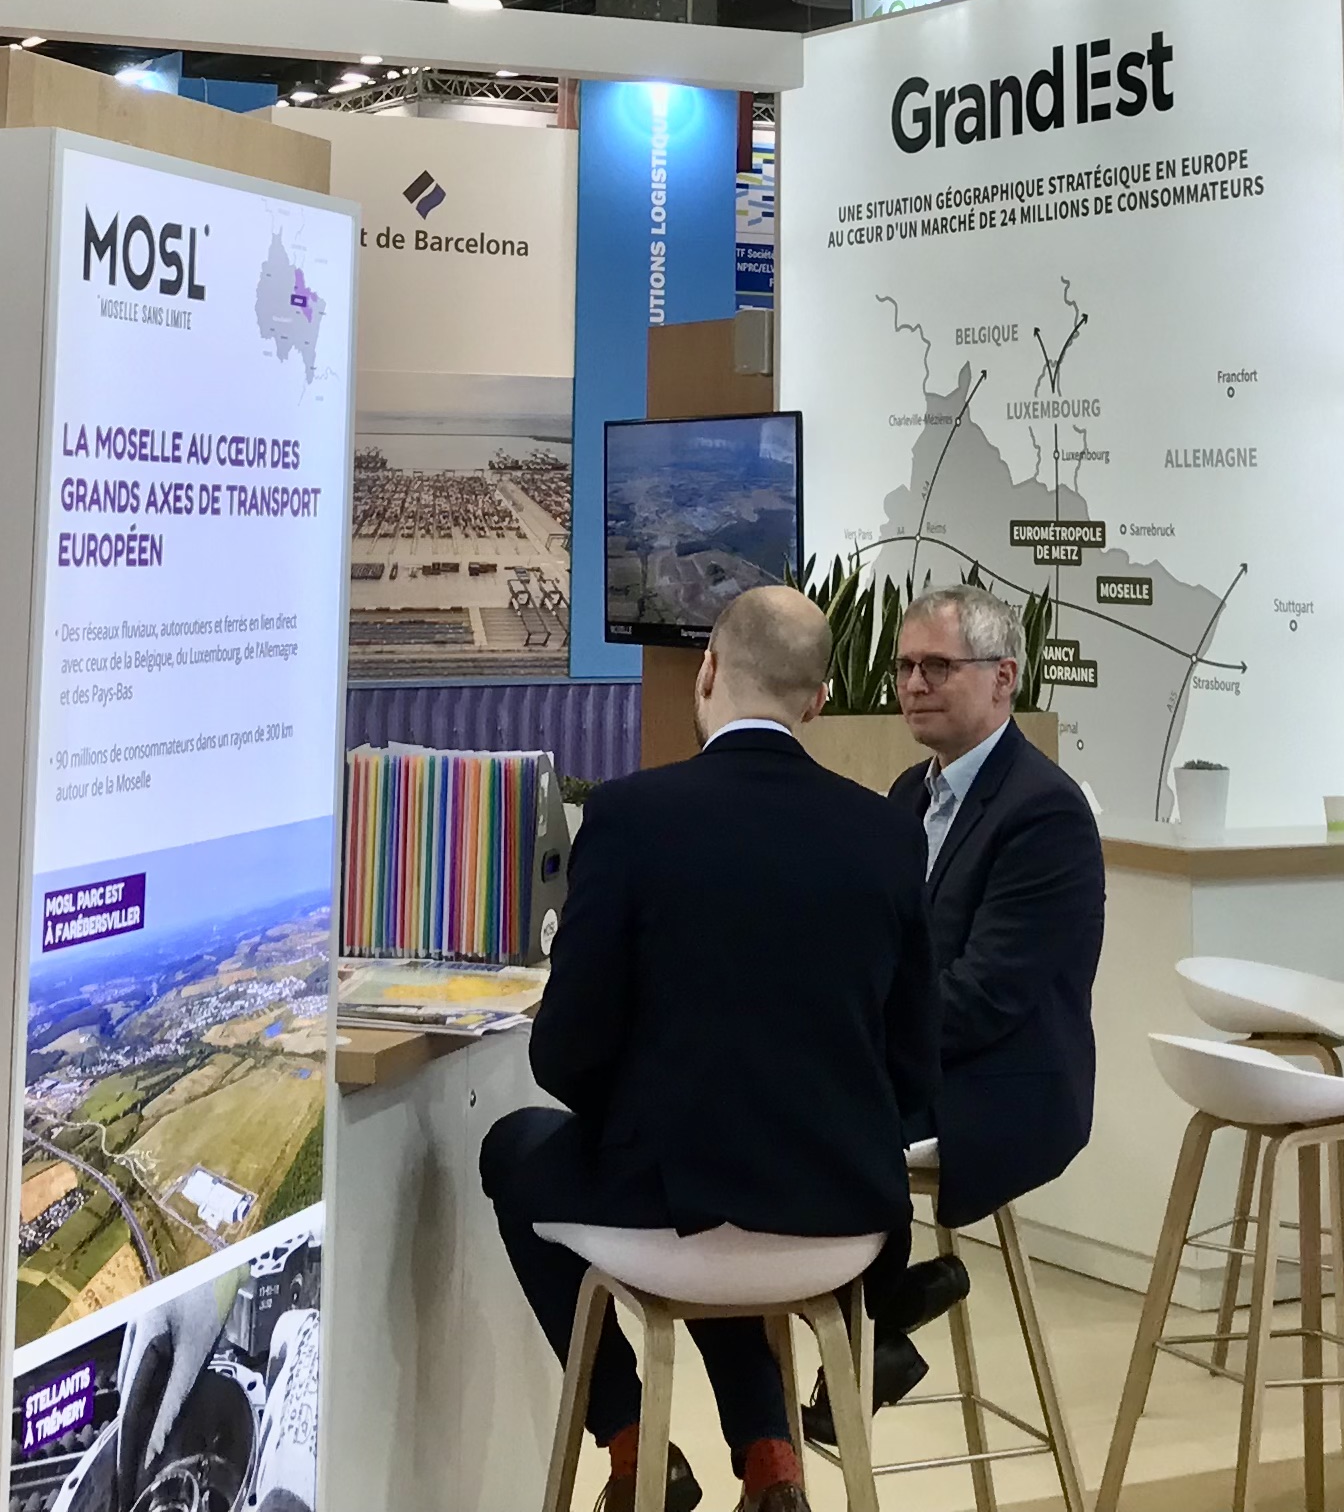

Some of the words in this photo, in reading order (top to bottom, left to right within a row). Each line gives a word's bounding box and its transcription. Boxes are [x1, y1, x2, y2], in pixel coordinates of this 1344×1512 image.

[838, 205, 863, 224] UNE
[866, 195, 932, 219] SITUATION
[936, 177, 1045, 214] GÉOGRAPHIQUE
[1048, 163, 1151, 196] STRATÉGIQUE
[1156, 159, 1176, 181] EN
[1181, 148, 1249, 177] EUROPE
[827, 230, 844, 249] AU
[886, 220, 917, 240] D'UN
[921, 208, 975, 237] MARCHÉ
[979, 211, 997, 229] DE
[1000, 208, 1017, 227] 24
[1020, 197, 1089, 225] MILLIONS
[1094, 195, 1113, 215] DE
[1117, 175, 1265, 212] CONSOMMATEURS
[375, 225, 406, 252] de
[414, 227, 530, 258] Barcelona
[97, 294, 139, 324] MOSELLE
[142, 305, 163, 326] SANS
[166, 307, 192, 331] LIMITE
[956, 323, 1019, 347] BELGIQUE
[1217, 368, 1258, 383] Francfort
[1007, 398, 1101, 420] LUXEMBOURG
[62, 422, 90, 459] LA
[95, 425, 183, 464] MOSELLE
[186, 434, 212, 466] AU
[216, 436, 267, 469] CŒUR
[270, 438, 300, 471] DES
[1061, 449, 1110, 464] Luxembourg
[1164, 447, 1257, 468] ALLEMAGNE
[60, 477, 140, 516] GRANDS
[145, 481, 194, 516] AXES
[199, 483, 222, 516] DE
[226, 486, 321, 518] TRANSPORT
[926, 522, 947, 535] Reims
[1013, 522, 1103, 542] EUROMÉTROPOLE
[1130, 523, 1175, 537] Sarrebruck
[58, 523, 163, 568] EUROPÉEN
[1036, 545, 1049, 559] DE
[1051, 545, 1079, 560] METZ
[1100, 582, 1149, 600] MOSELLE
[1274, 598, 1314, 615] Stuttgart
[61, 623, 80, 642] Des
[82, 622, 119, 641] réseaux
[1042, 646, 1075, 662] NANCY
[1044, 665, 1094, 683] LORRAINE
[1192, 676, 1241, 695] Strasbourg
[124, 737, 194, 762] consommateurs
[45, 892, 75, 917] MOSL
[76, 886, 104, 912] PARC
[104, 881, 124, 905] EST
[25, 1366, 91, 1419] STELLANTIS
[36, 1396, 87, 1443] TRÉMERY
